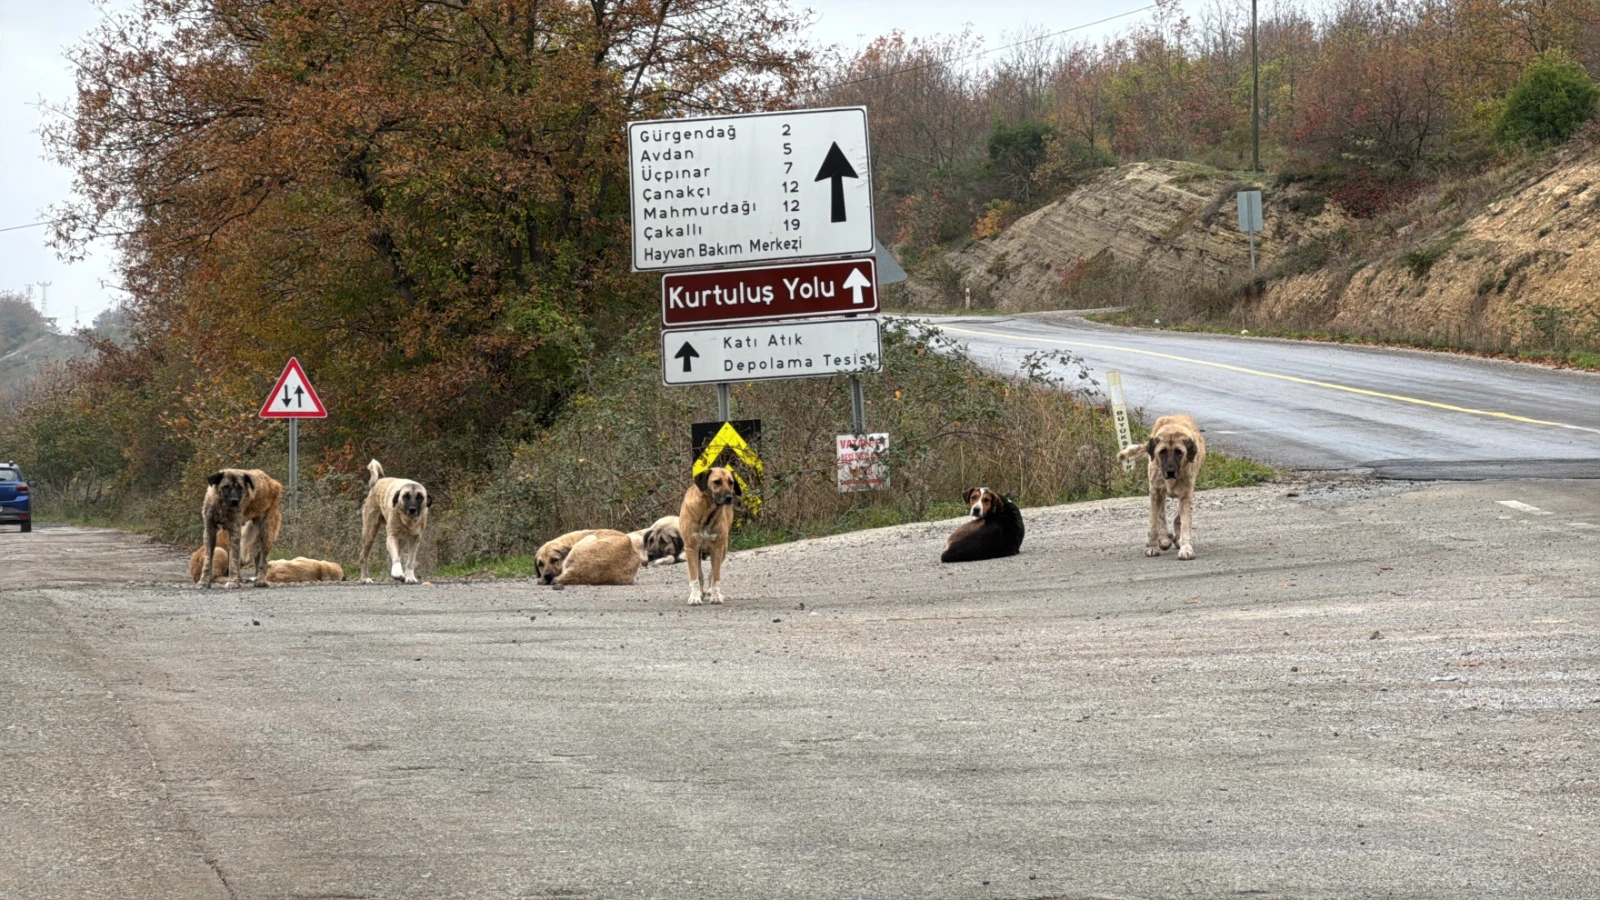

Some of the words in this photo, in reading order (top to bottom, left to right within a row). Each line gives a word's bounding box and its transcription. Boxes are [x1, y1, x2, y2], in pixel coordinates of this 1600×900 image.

[639, 125, 737, 143] Gürgendağ
[782, 123, 792, 136] 2
[640, 149, 694, 162] Avdan
[783, 142, 793, 155] 5
[641, 166, 711, 182] Üçpınar
[783, 161, 793, 174] 7
[642, 186, 711, 203] Çanakçı
[782, 181, 800, 194] 12
[643, 200, 757, 220] Mahmurdağı
[783, 199, 800, 212] 12
[643, 224, 702, 240] Çakallı
[783, 218, 801, 231] 19
[644, 247, 695, 263] Hayvan
[698, 243, 743, 256] Bakım
[749, 236, 803, 253] Merkezi
[669, 281, 775, 309] Kurtuluş
[782, 276, 836, 300] Yolu
[723, 336, 758, 349] Katı
[768, 333, 803, 347] Atık
[724, 357, 813, 373] Depolama
